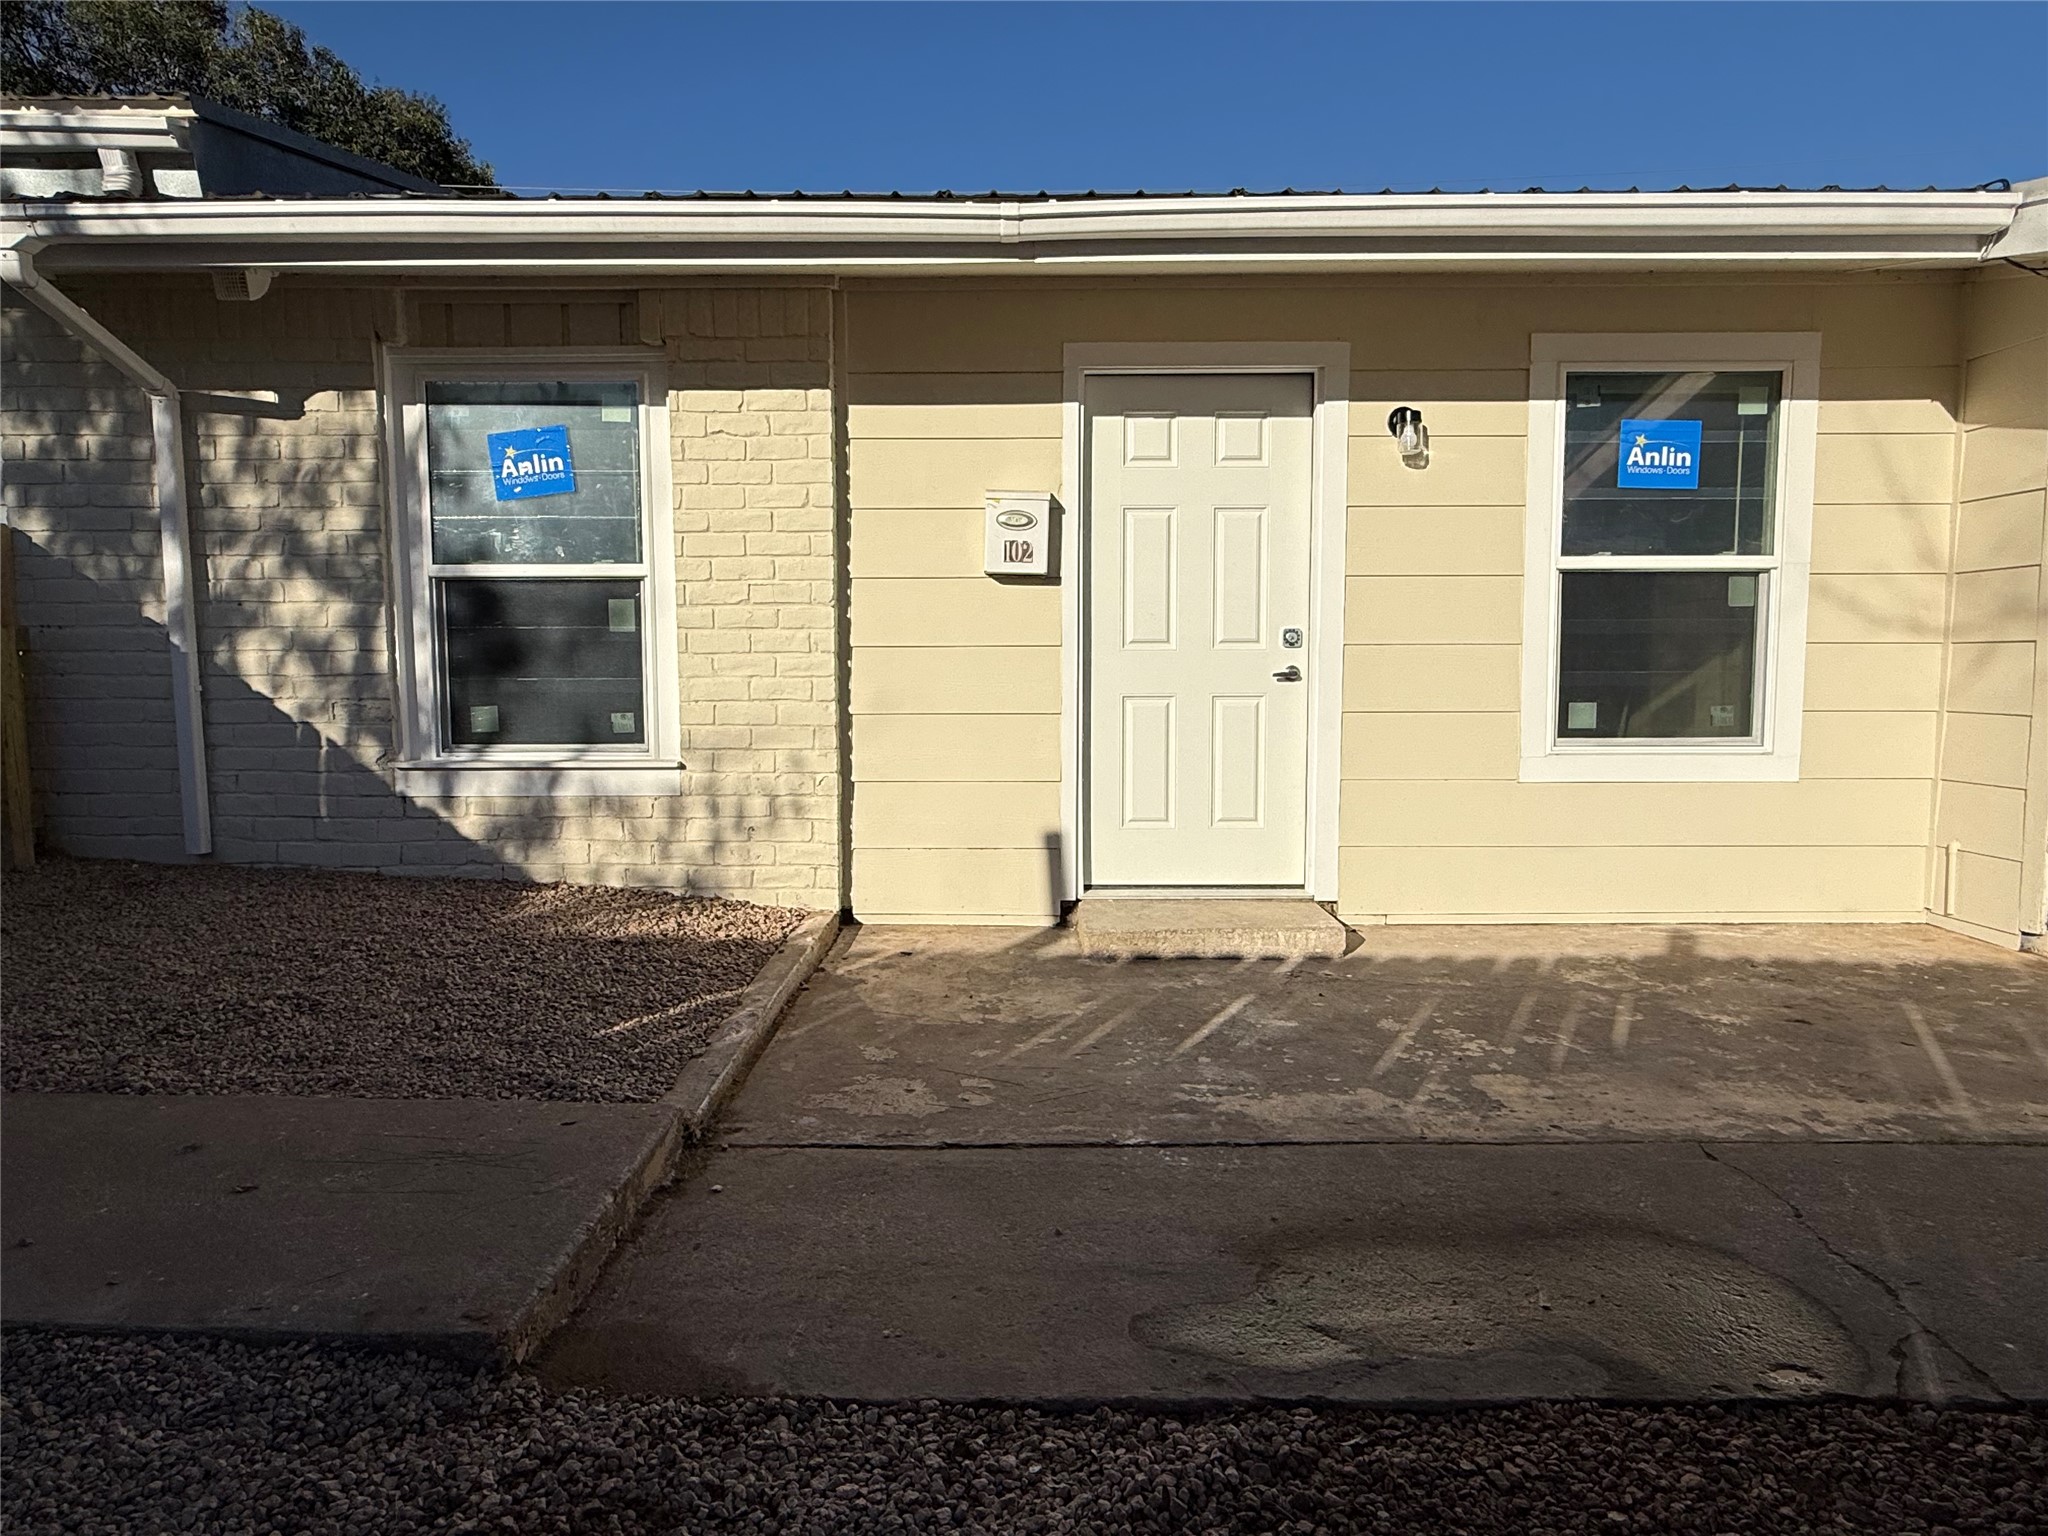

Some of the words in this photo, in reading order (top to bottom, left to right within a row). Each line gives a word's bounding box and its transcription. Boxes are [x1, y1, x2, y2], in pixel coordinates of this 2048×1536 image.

[501, 453, 564, 478] Anlin
[1626, 446, 1691, 466] Anlin
[1003, 540, 1033, 563] 102
